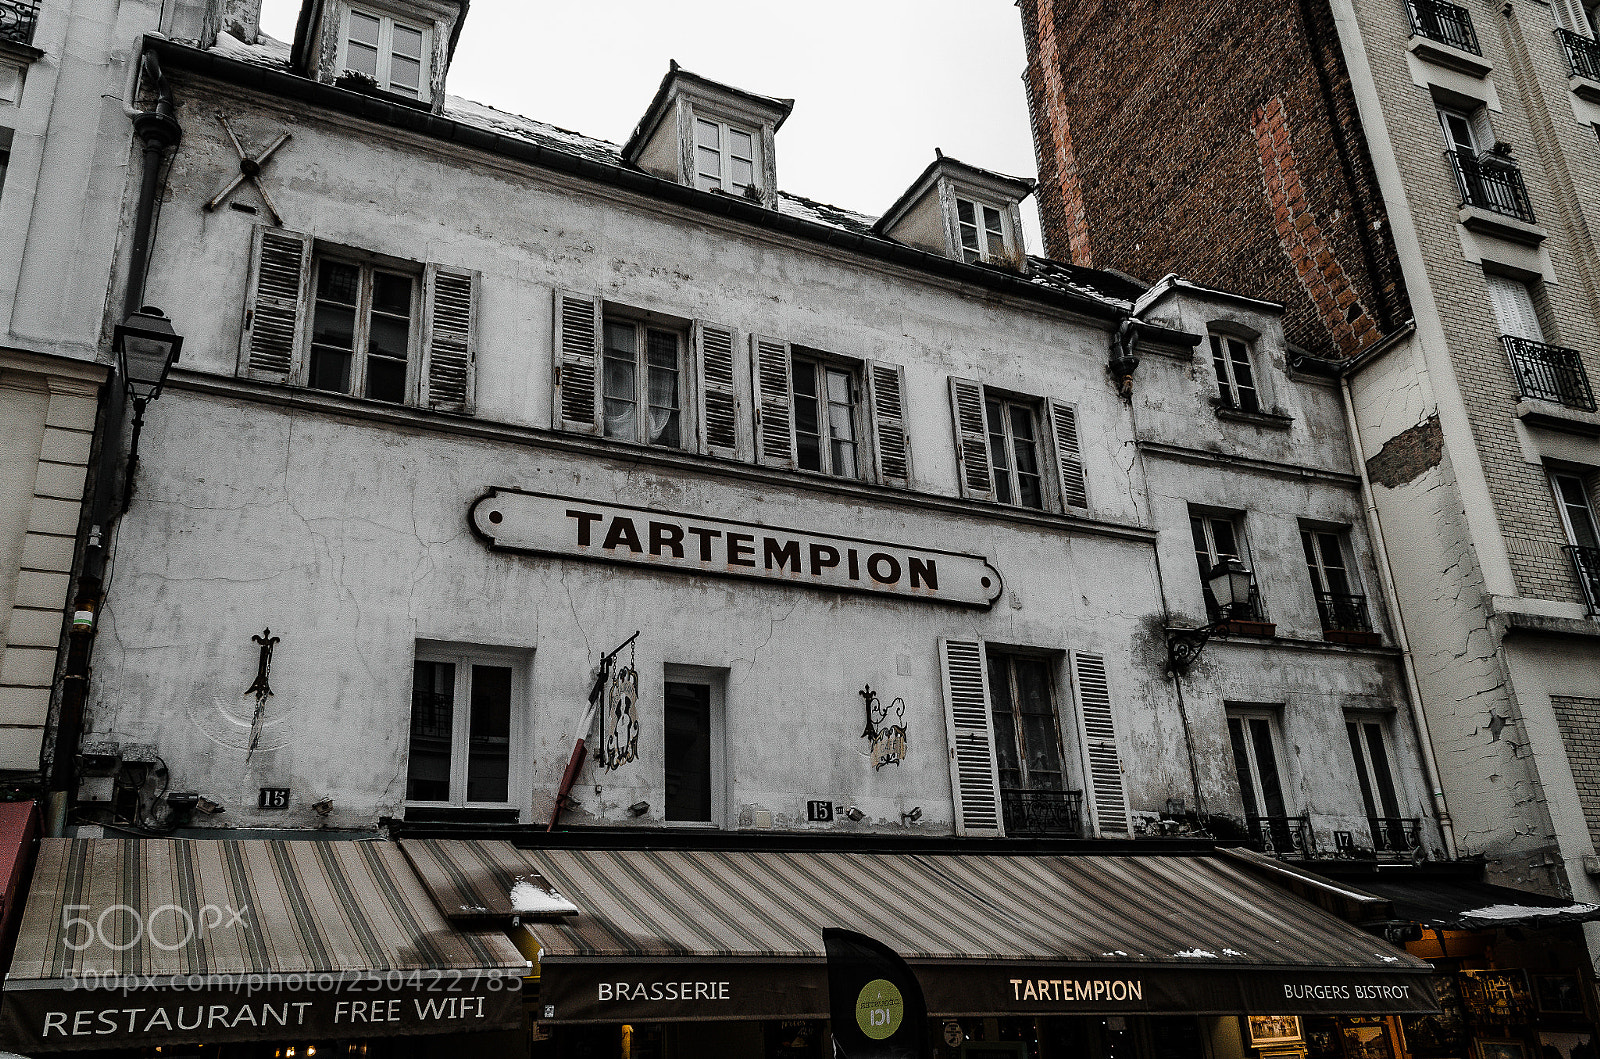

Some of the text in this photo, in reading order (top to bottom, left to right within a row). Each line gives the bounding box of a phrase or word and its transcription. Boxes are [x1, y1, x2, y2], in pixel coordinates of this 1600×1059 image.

[565, 509, 939, 591] TARTEMPION
[264, 791, 285, 806] 15
[812, 802, 829, 820] 15
[1337, 833, 1349, 846] 17
[597, 981, 730, 1001] BRASSERIE
[1009, 978, 1143, 1002] TARTEMPION
[1283, 984, 1410, 1000] BURGERS BISTROT
[42, 996, 486, 1037] RESTAURANT FREE WIFI
